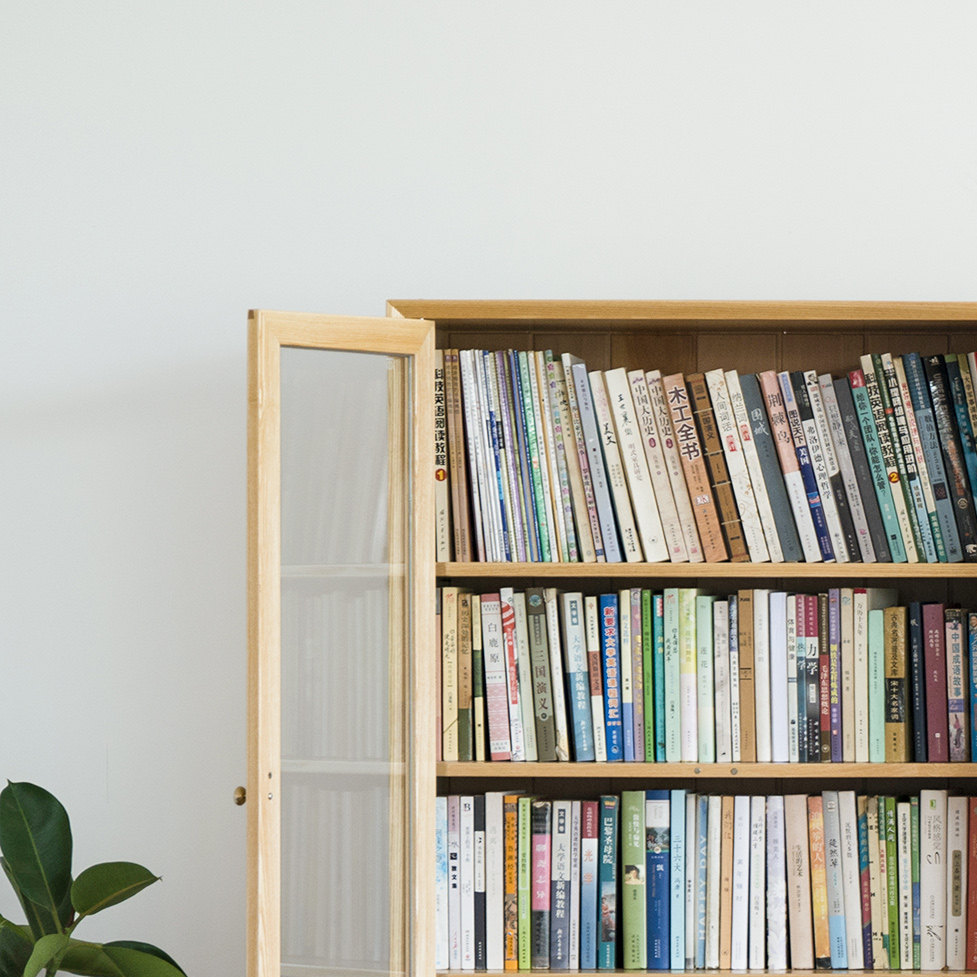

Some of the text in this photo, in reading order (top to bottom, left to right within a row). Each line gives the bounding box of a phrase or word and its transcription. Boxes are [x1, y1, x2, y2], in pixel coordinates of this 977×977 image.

[667, 386, 701, 461] 木工全书
[714, 391, 731, 432] 人间词话
[767, 392, 790, 444] 荆棘鸟
[788, 409, 804, 444] 图说天下
[865, 373, 898, 468] 科技英语阅读教程
[487, 622, 500, 664] 白鹿原
[806, 643, 819, 676] 力学
[951, 632, 962, 697] 中国成语故事
[534, 650, 549, 710] 三国演义
[602, 817, 614, 864] 巴黎圣母院
[672, 836, 682, 873] 三十六大
[811, 811, 823, 862] 追风筝的人
